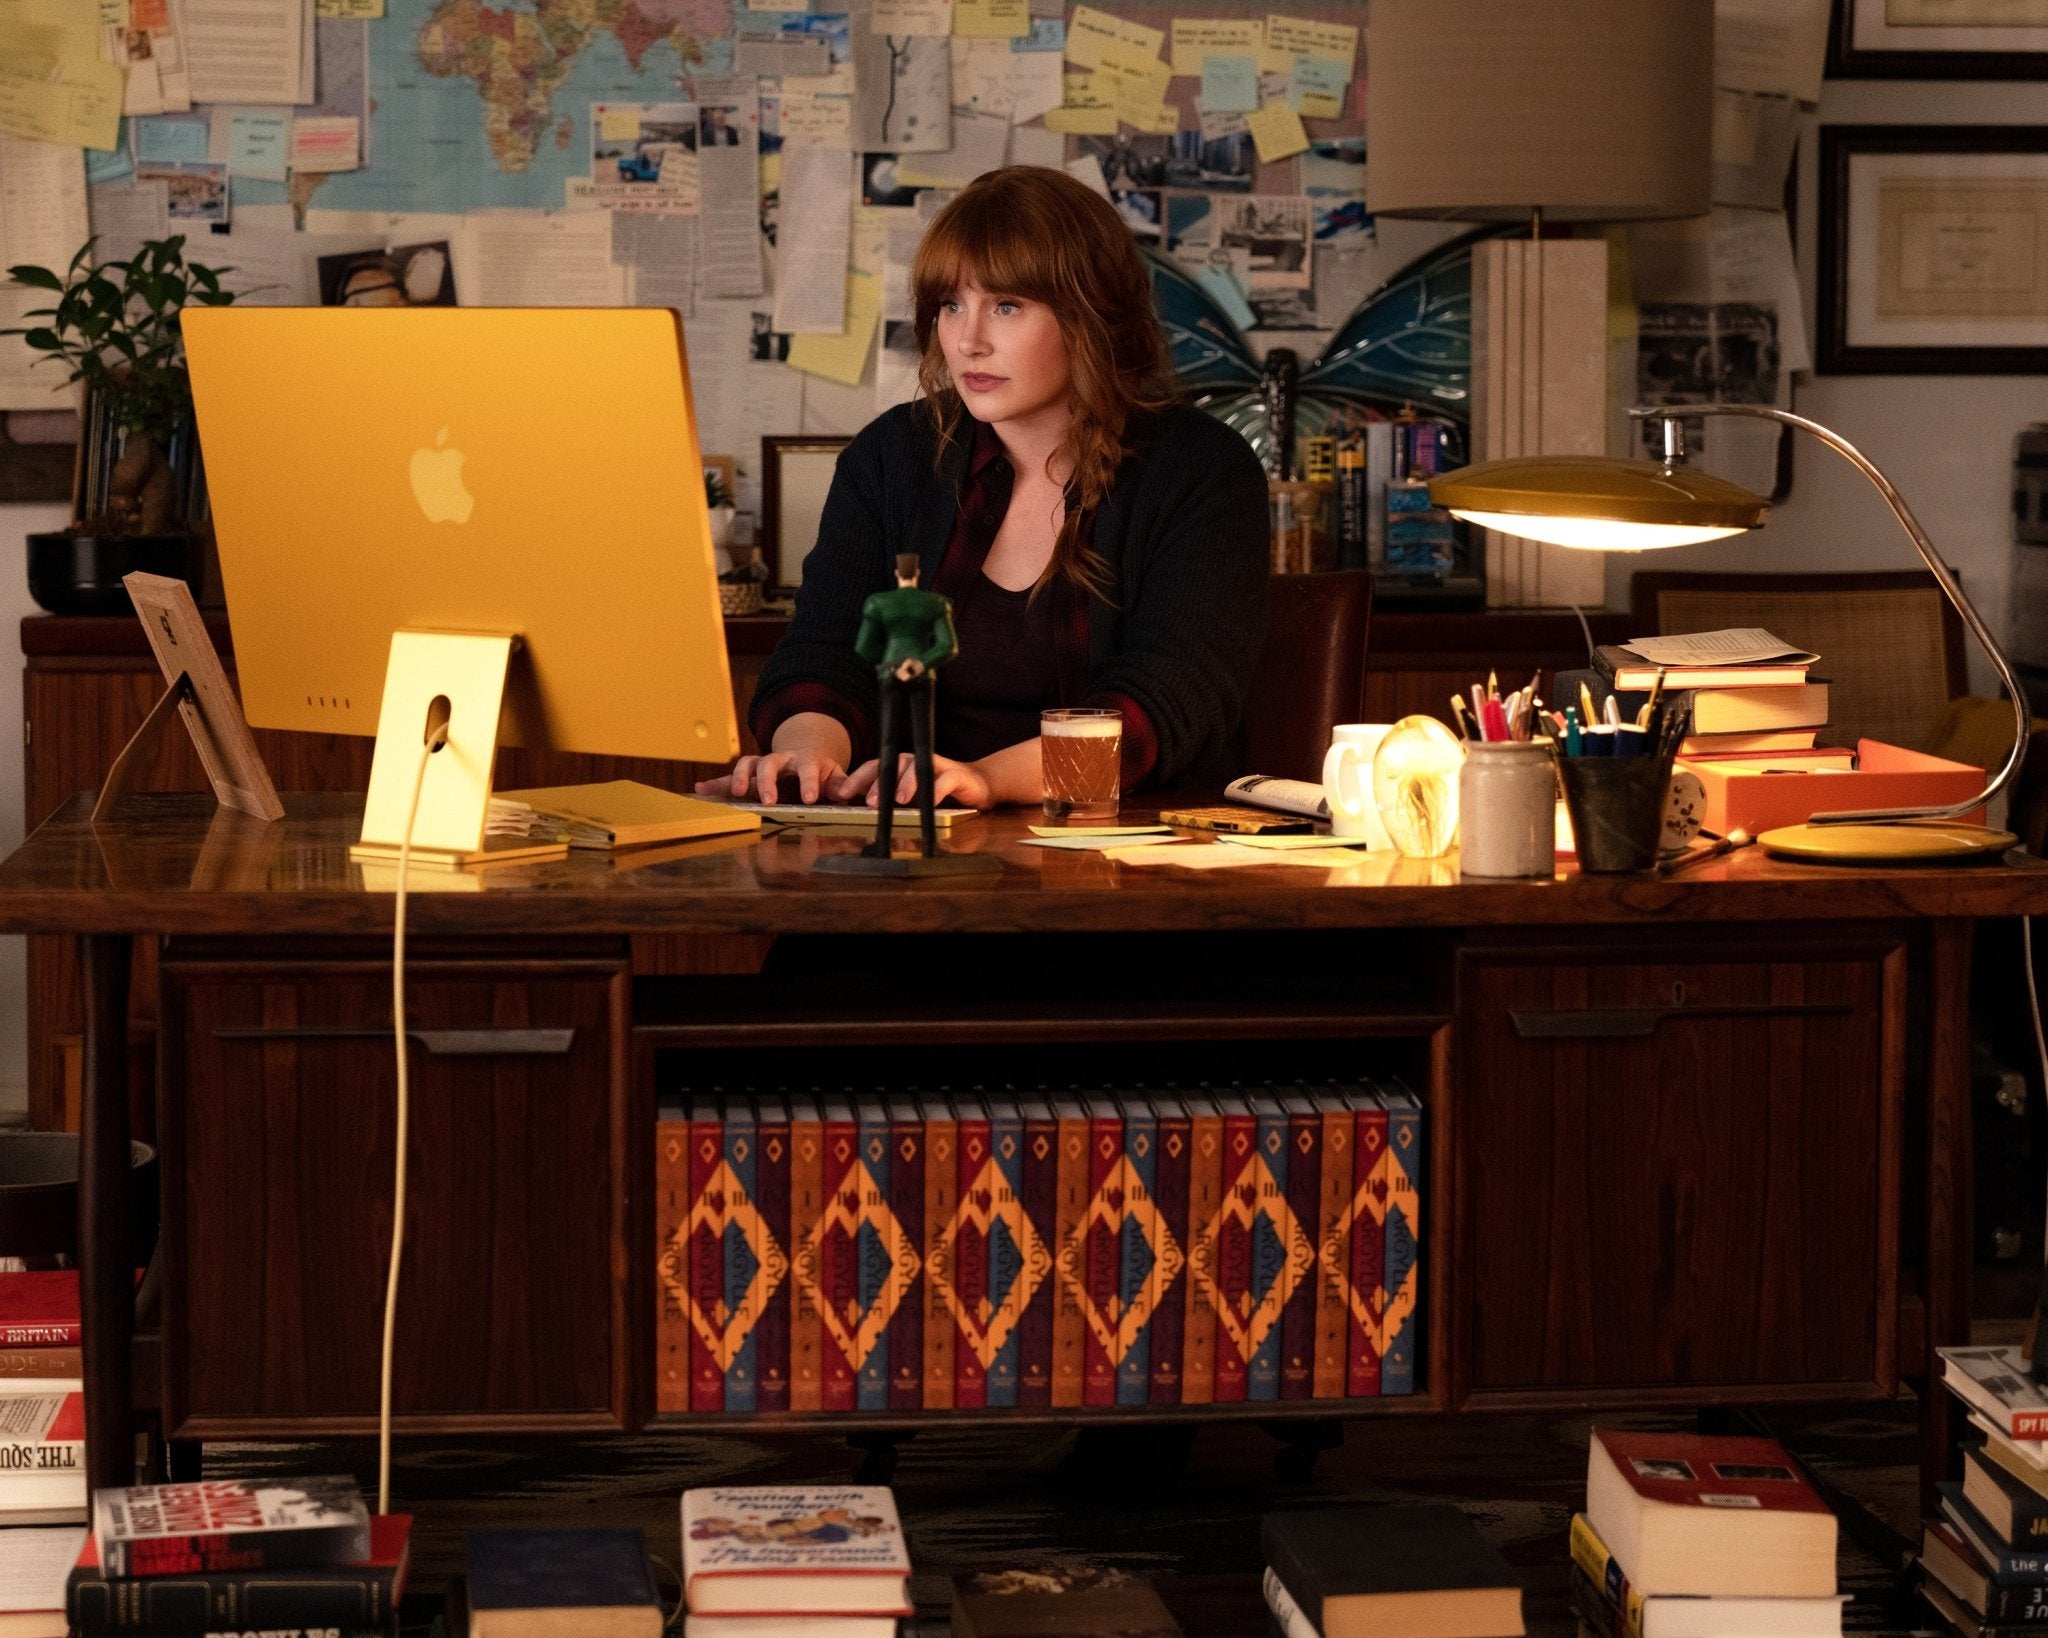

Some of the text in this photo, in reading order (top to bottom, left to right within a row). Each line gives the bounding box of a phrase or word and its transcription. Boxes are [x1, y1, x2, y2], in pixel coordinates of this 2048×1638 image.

[665, 1226, 681, 1320] ARGYLLE
[732, 1226, 749, 1320] ARGYLLE
[799, 1225, 815, 1320] ARGYLLE
[866, 1225, 882, 1320] ARGYLLE
[931, 1224, 948, 1319] ARGYLLE
[997, 1222, 1013, 1316] ARGYLLE
[1063, 1221, 1079, 1315] ARGYLLE
[1129, 1221, 1145, 1314] ARGYLLE
[1195, 1218, 1210, 1313] ARGYLLE
[1259, 1218, 1275, 1310] ARGYLLE
[1324, 1214, 1340, 1308] ARGYLLE
[1393, 1212, 1409, 1304] ARGYLLE
[7, 1328, 69, 1343] BRITAIN
[37, 1446, 76, 1468] THE
[2019, 1418, 2037, 1432] SPY
[2011, 1559, 2038, 1572] the
